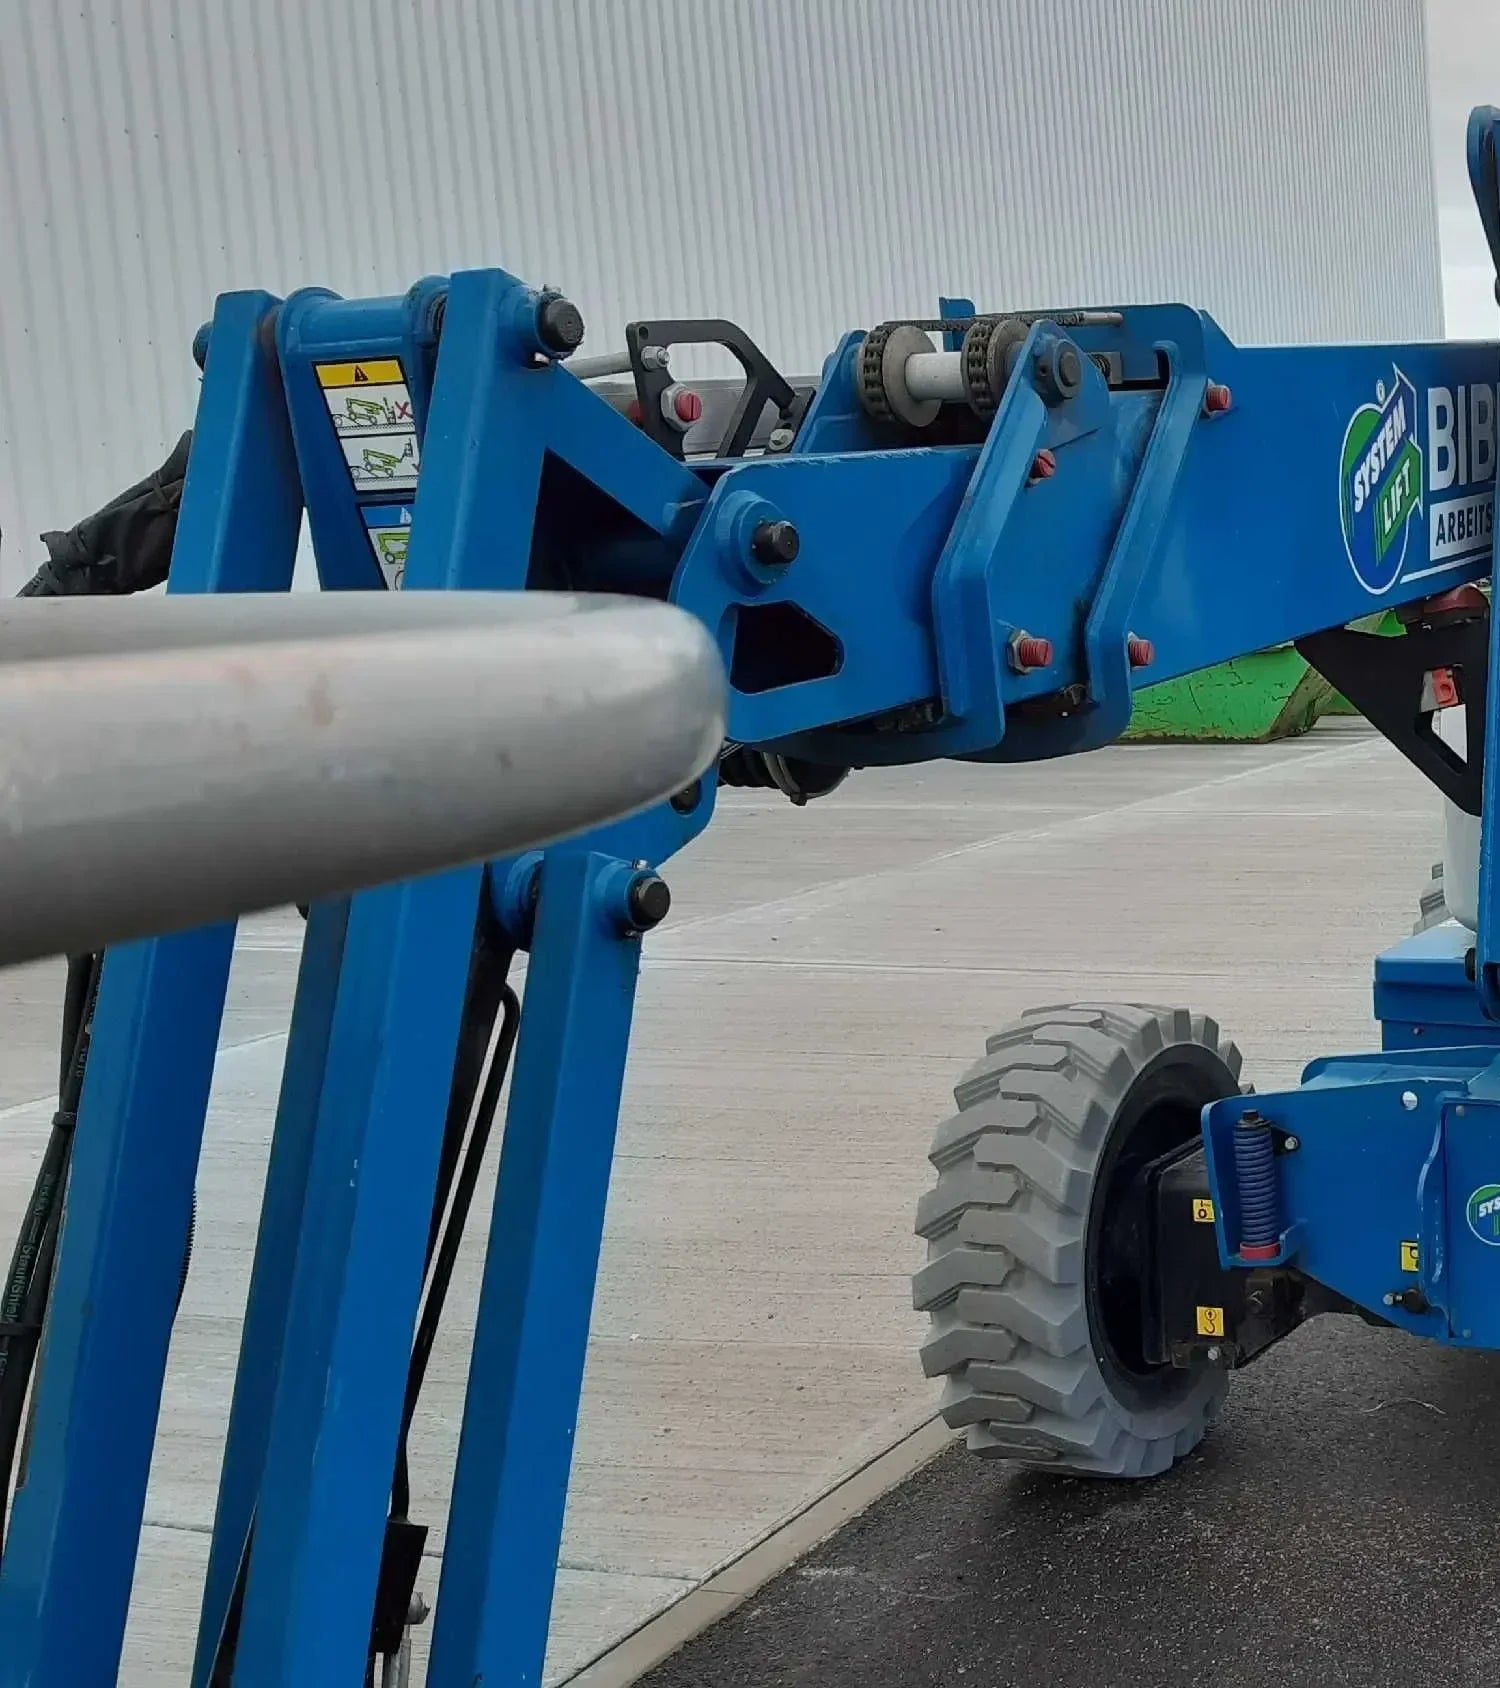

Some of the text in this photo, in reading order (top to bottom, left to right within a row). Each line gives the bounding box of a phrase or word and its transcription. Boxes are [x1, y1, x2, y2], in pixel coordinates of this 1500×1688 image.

[1354, 396, 1407, 513] SYSTEM
[1428, 383, 1500, 492] BIB
[1383, 459, 1411, 537] LIFT
